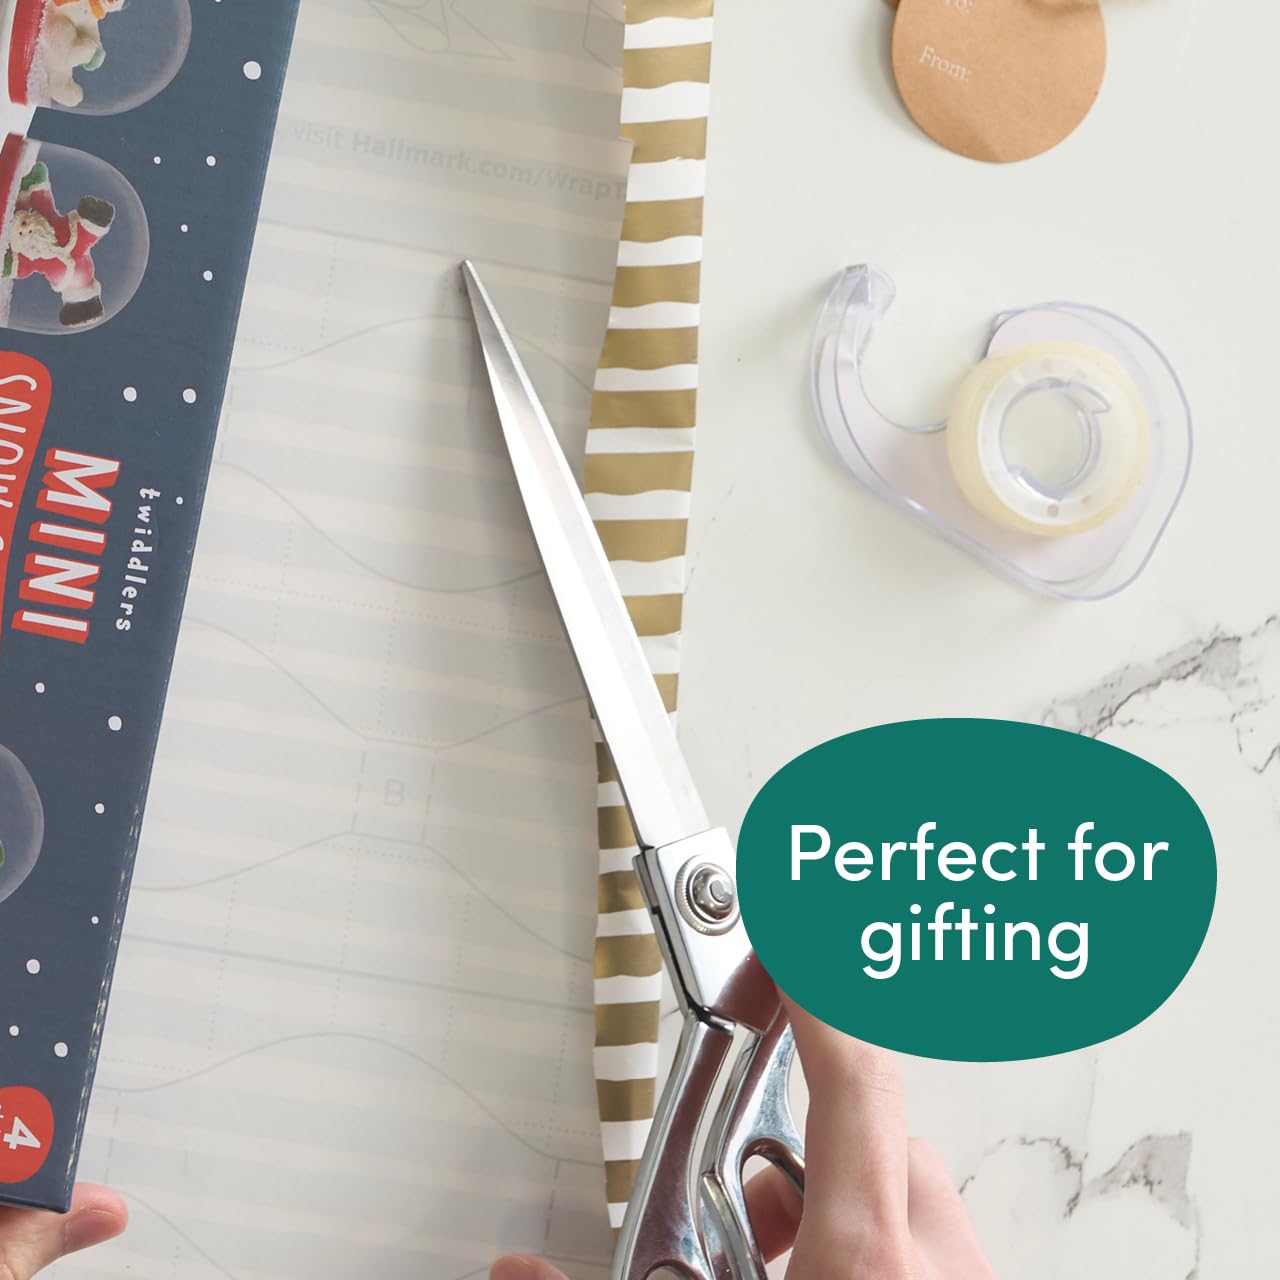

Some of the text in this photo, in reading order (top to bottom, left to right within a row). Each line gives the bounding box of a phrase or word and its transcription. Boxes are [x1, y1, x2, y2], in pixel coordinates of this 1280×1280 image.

[12, 447, 121, 646] MINI
[115, 487, 161, 632] twiddlers
[2, 1116, 41, 1150] 4
